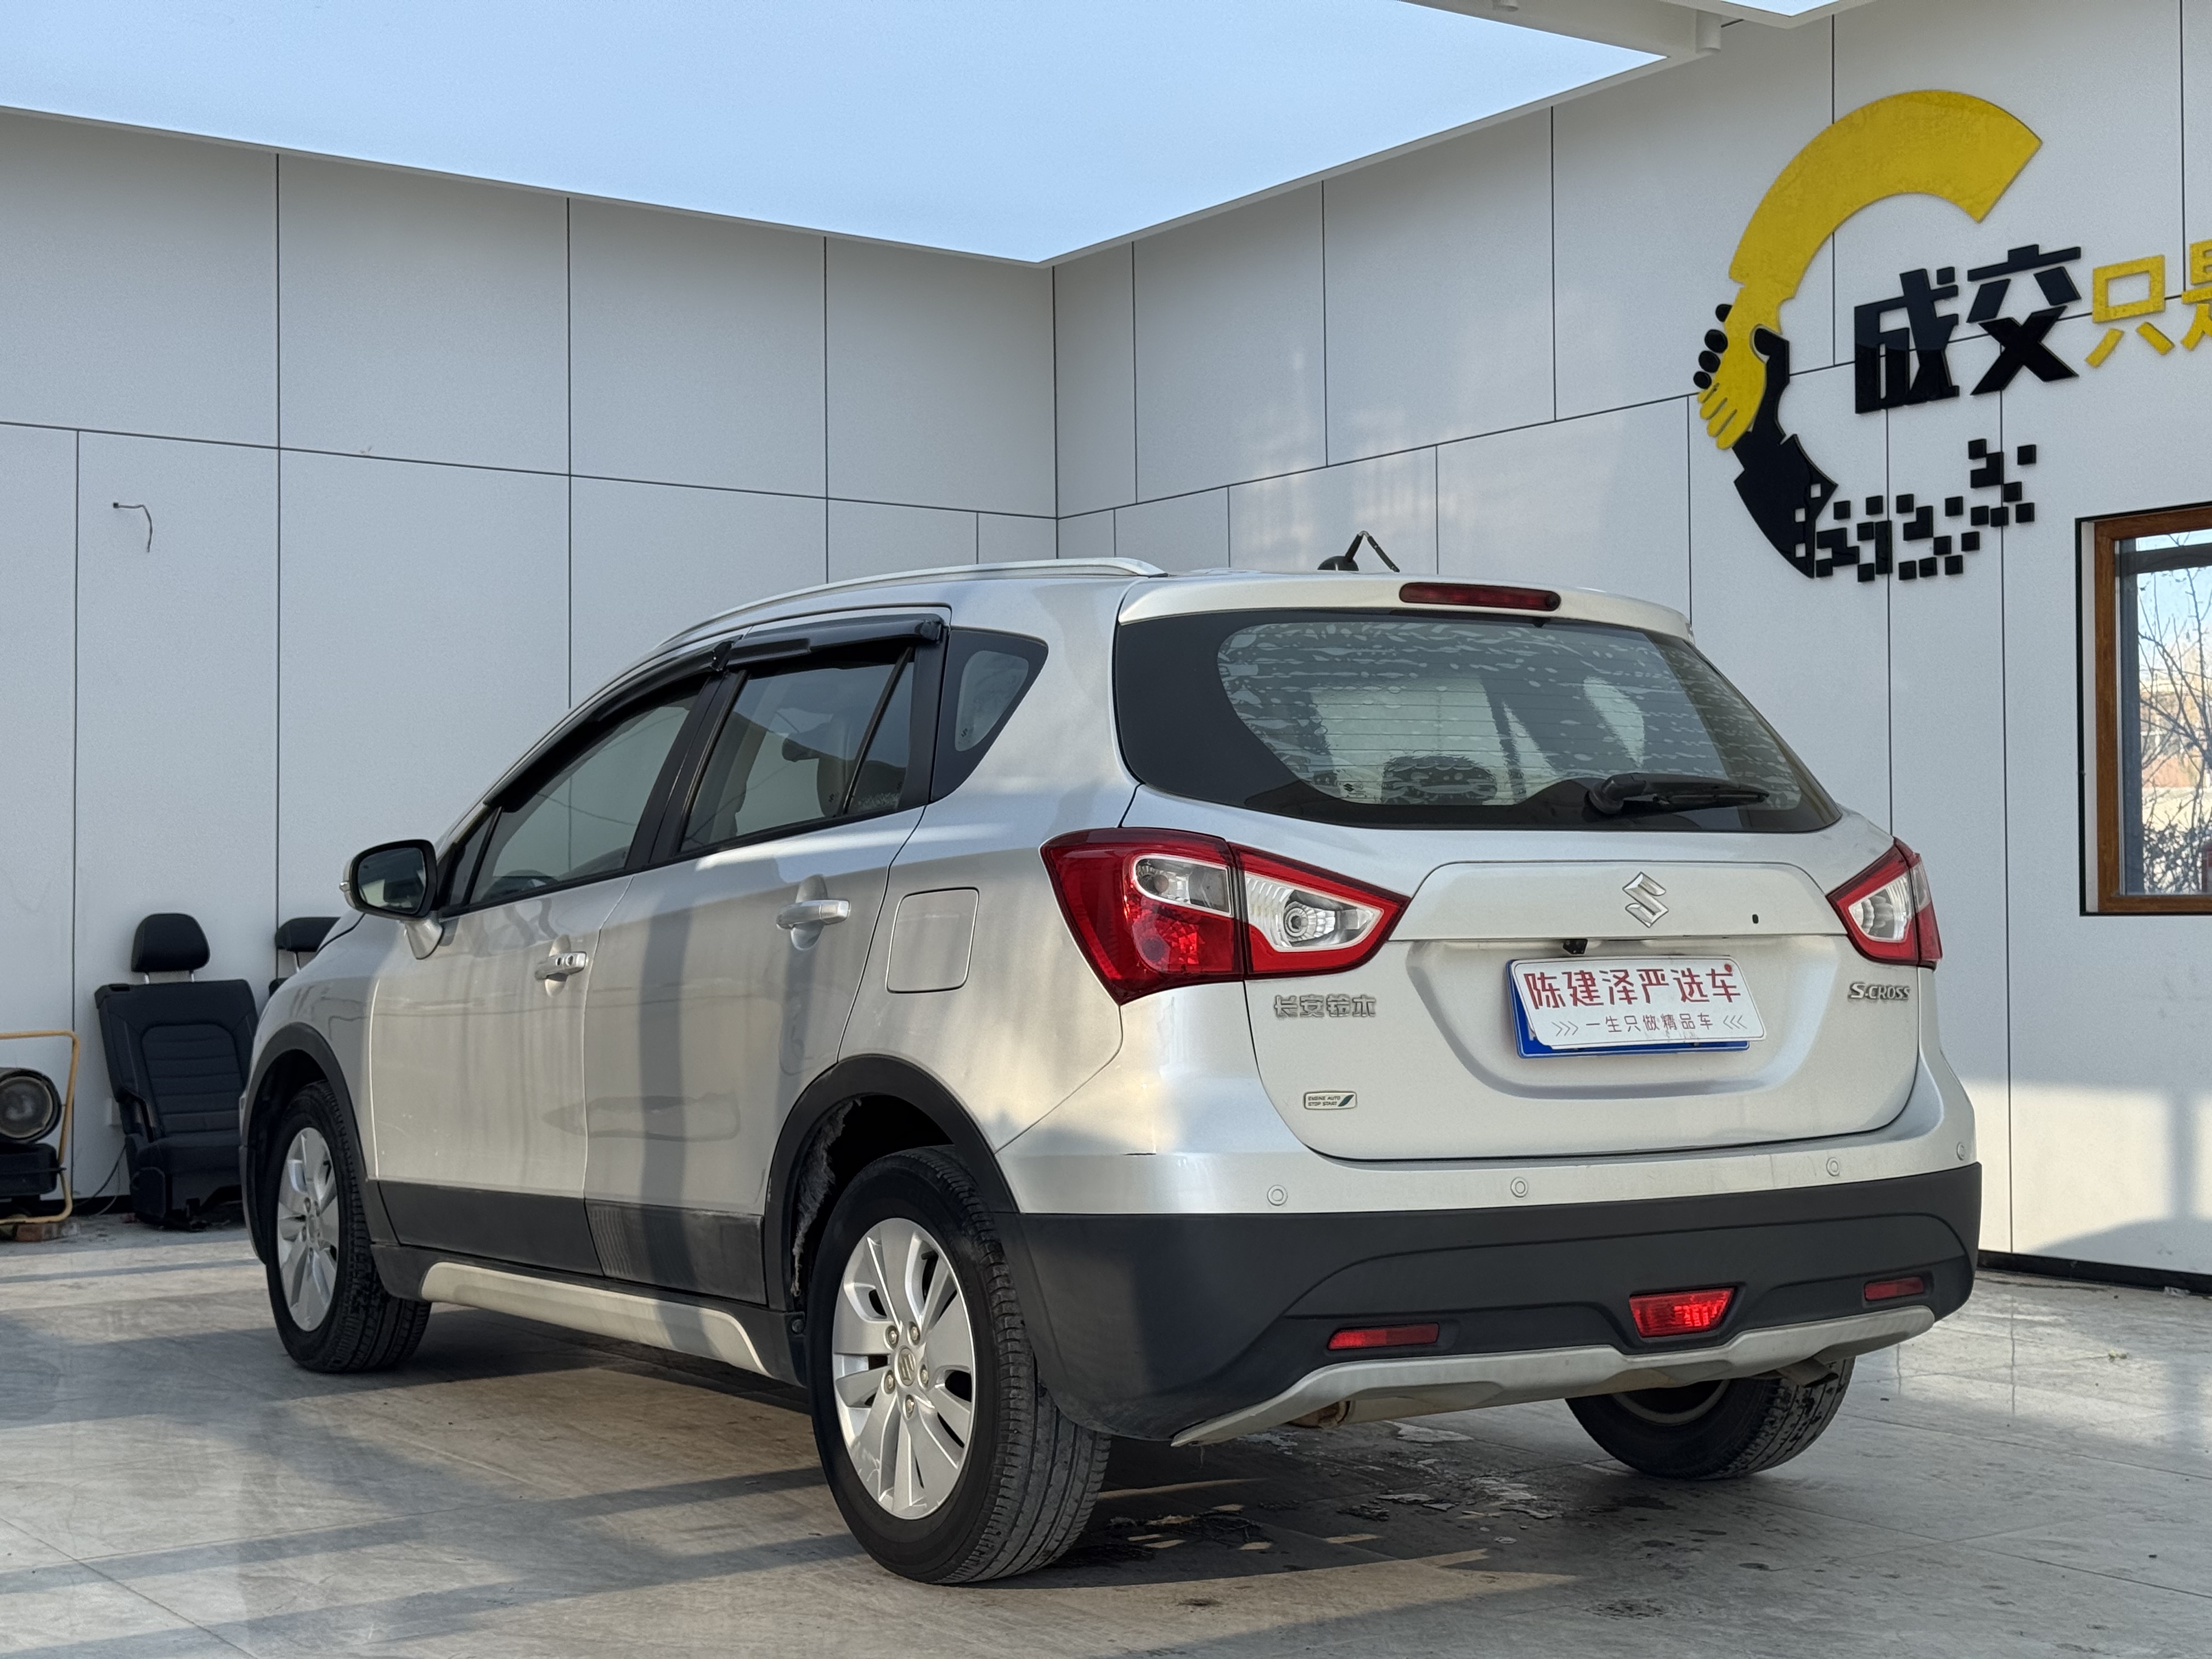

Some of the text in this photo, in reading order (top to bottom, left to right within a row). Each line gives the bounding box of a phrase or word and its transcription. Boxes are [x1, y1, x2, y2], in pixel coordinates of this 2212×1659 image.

[1523, 968, 1741, 1010] 陈建泽严选车
[1274, 994, 1376, 1018] 长安铃木
[1585, 1013, 1713, 1033] 一生只做精品车
